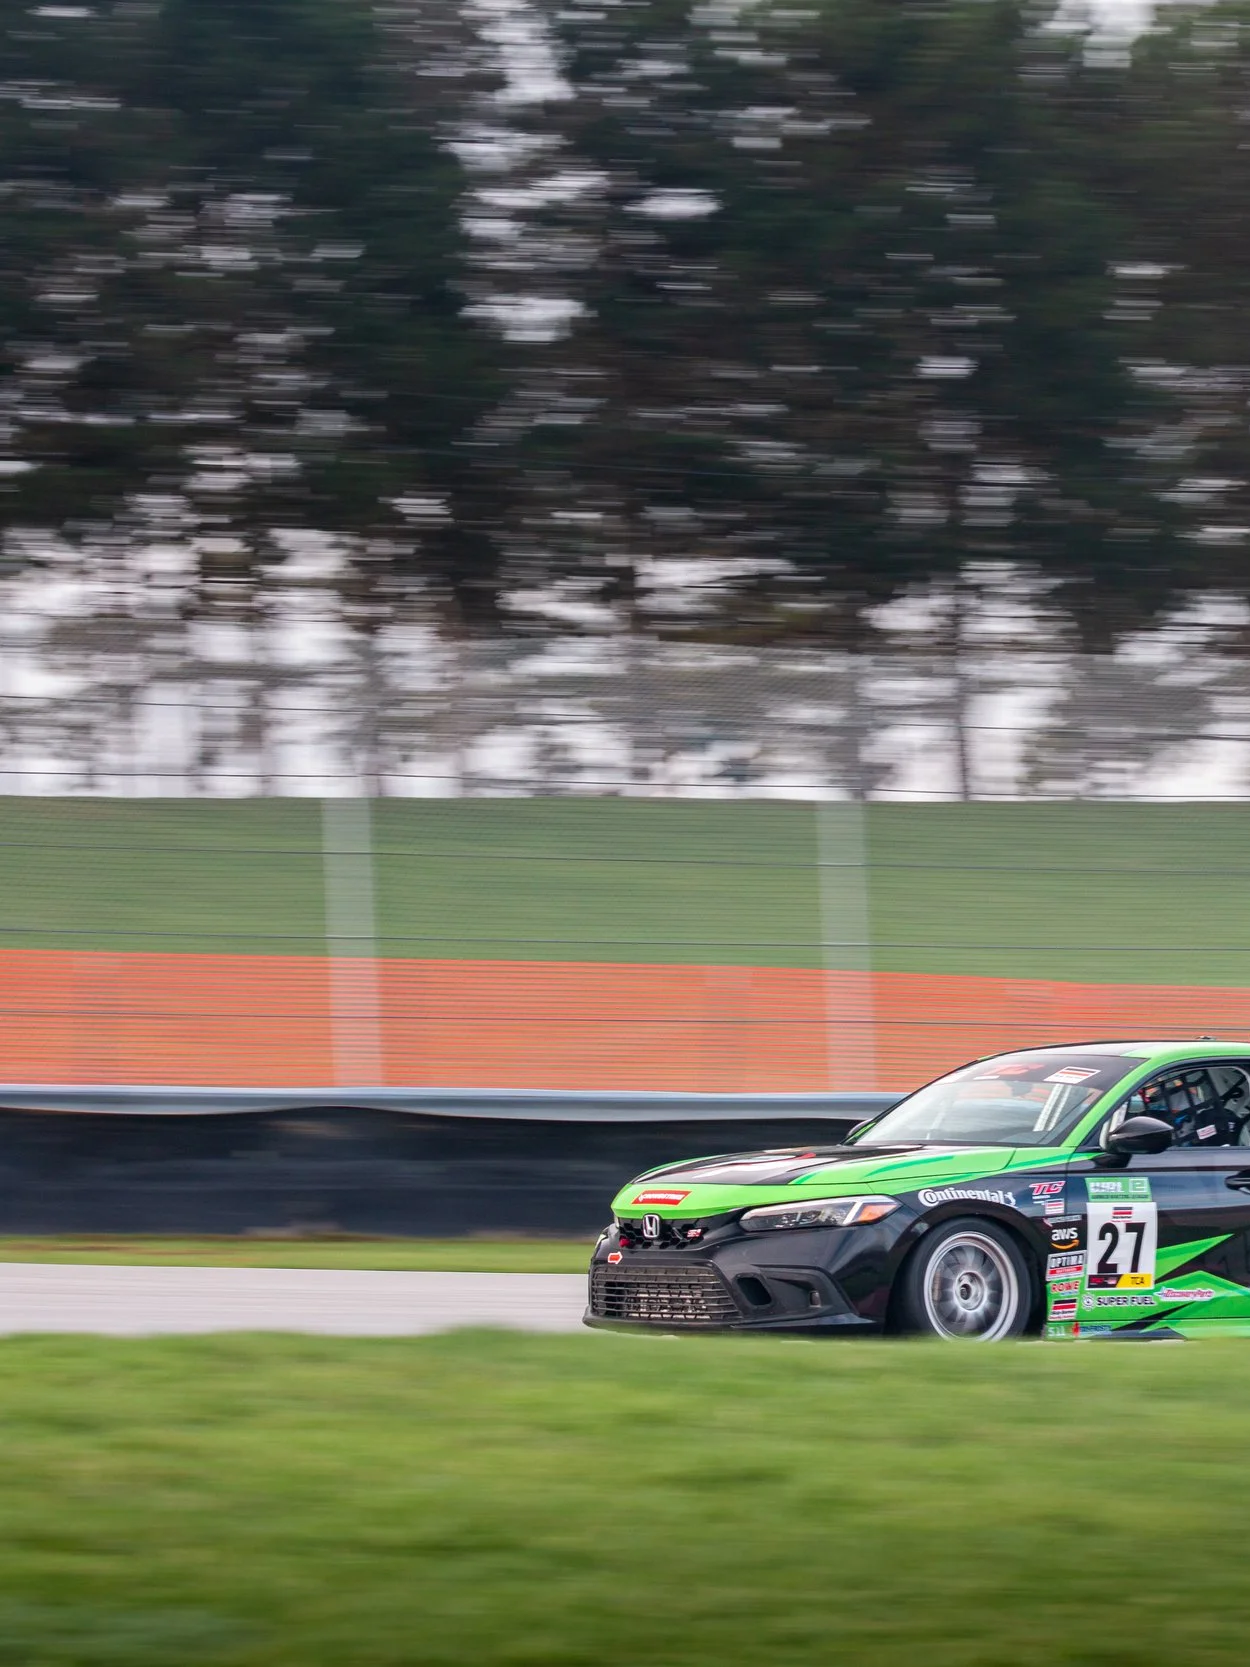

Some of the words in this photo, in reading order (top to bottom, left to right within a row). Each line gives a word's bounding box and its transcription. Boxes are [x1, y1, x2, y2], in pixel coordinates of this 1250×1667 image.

[1030, 1181, 1066, 1195] TC
[918, 1187, 1004, 1207] Continental
[1051, 1227, 1079, 1241] aws
[1098, 1221, 1147, 1274] 27
[1051, 1254, 1083, 1268] OPTIMA
[1051, 1281, 1079, 1293] ROWE
[1130, 1276, 1145, 1285] TCA
[1096, 1296, 1127, 1306] SUPER
[1131, 1296, 1156, 1306] FUEL
